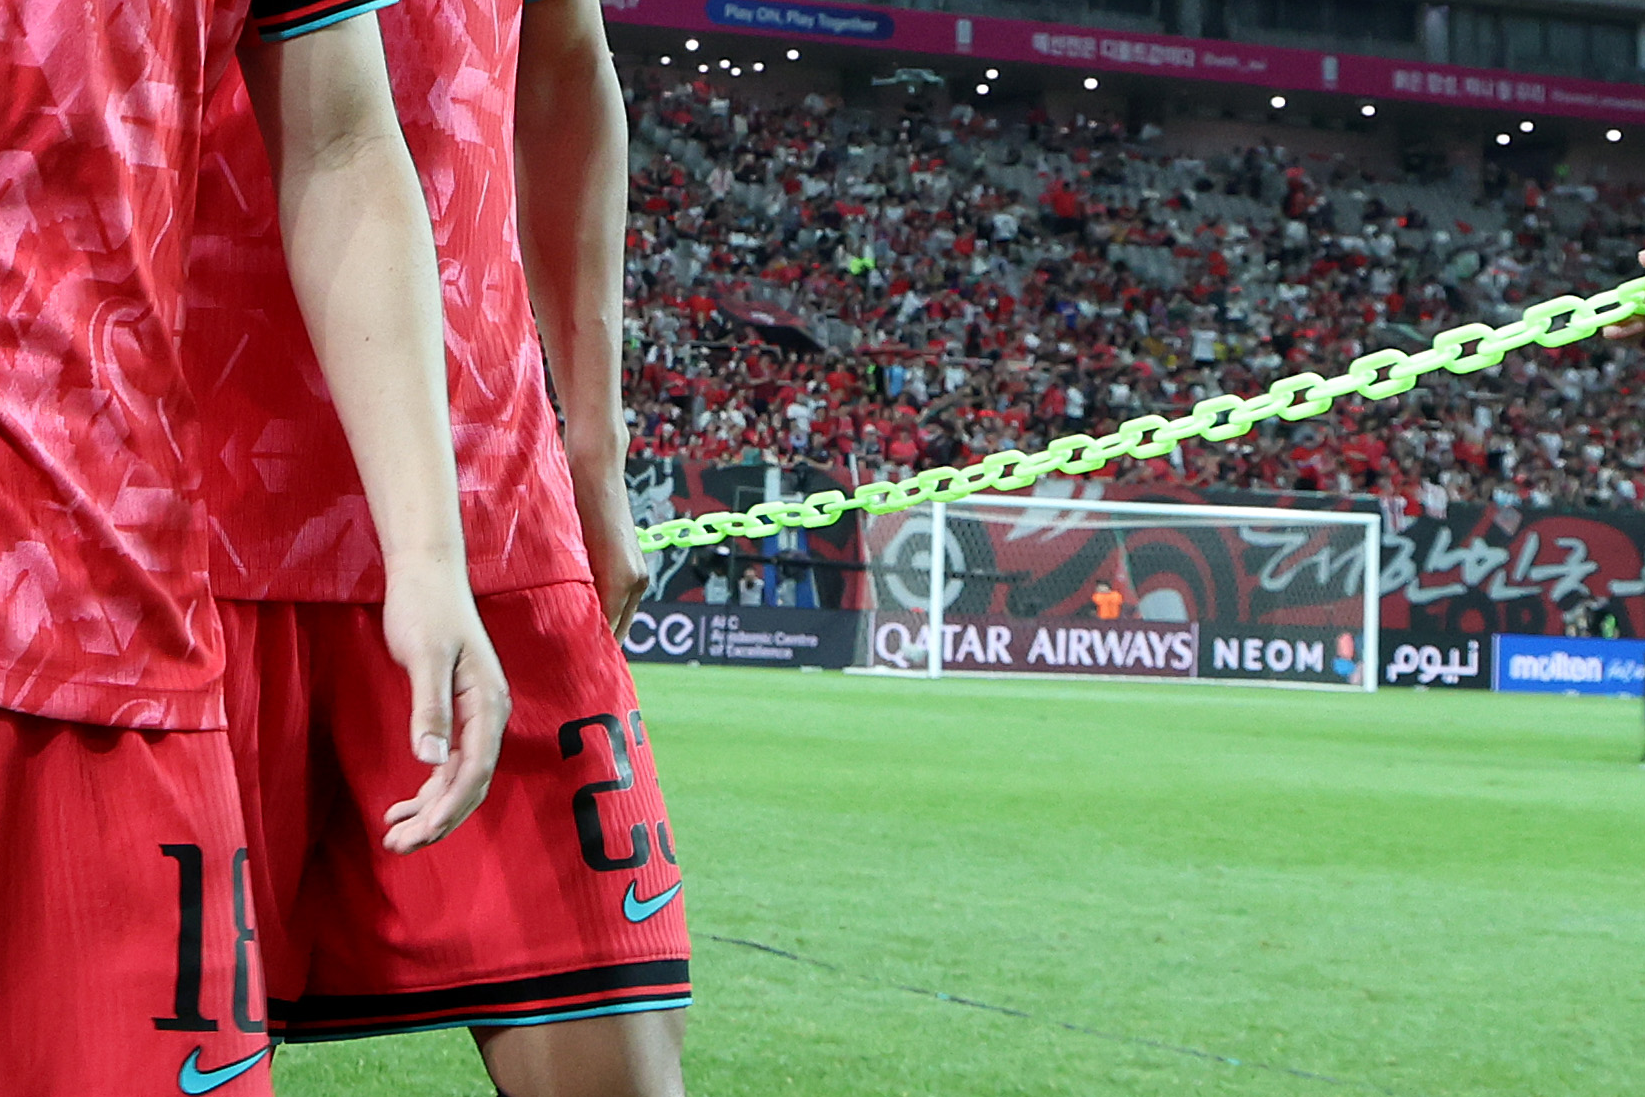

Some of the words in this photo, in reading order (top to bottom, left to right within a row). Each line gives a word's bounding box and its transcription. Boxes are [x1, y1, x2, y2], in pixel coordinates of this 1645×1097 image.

[1026, 625, 1193, 671] AIRWAYS
[1212, 636, 1325, 673] NEOM
[1386, 639, 1480, 684] نيوم
[1509, 650, 1603, 683] molten
